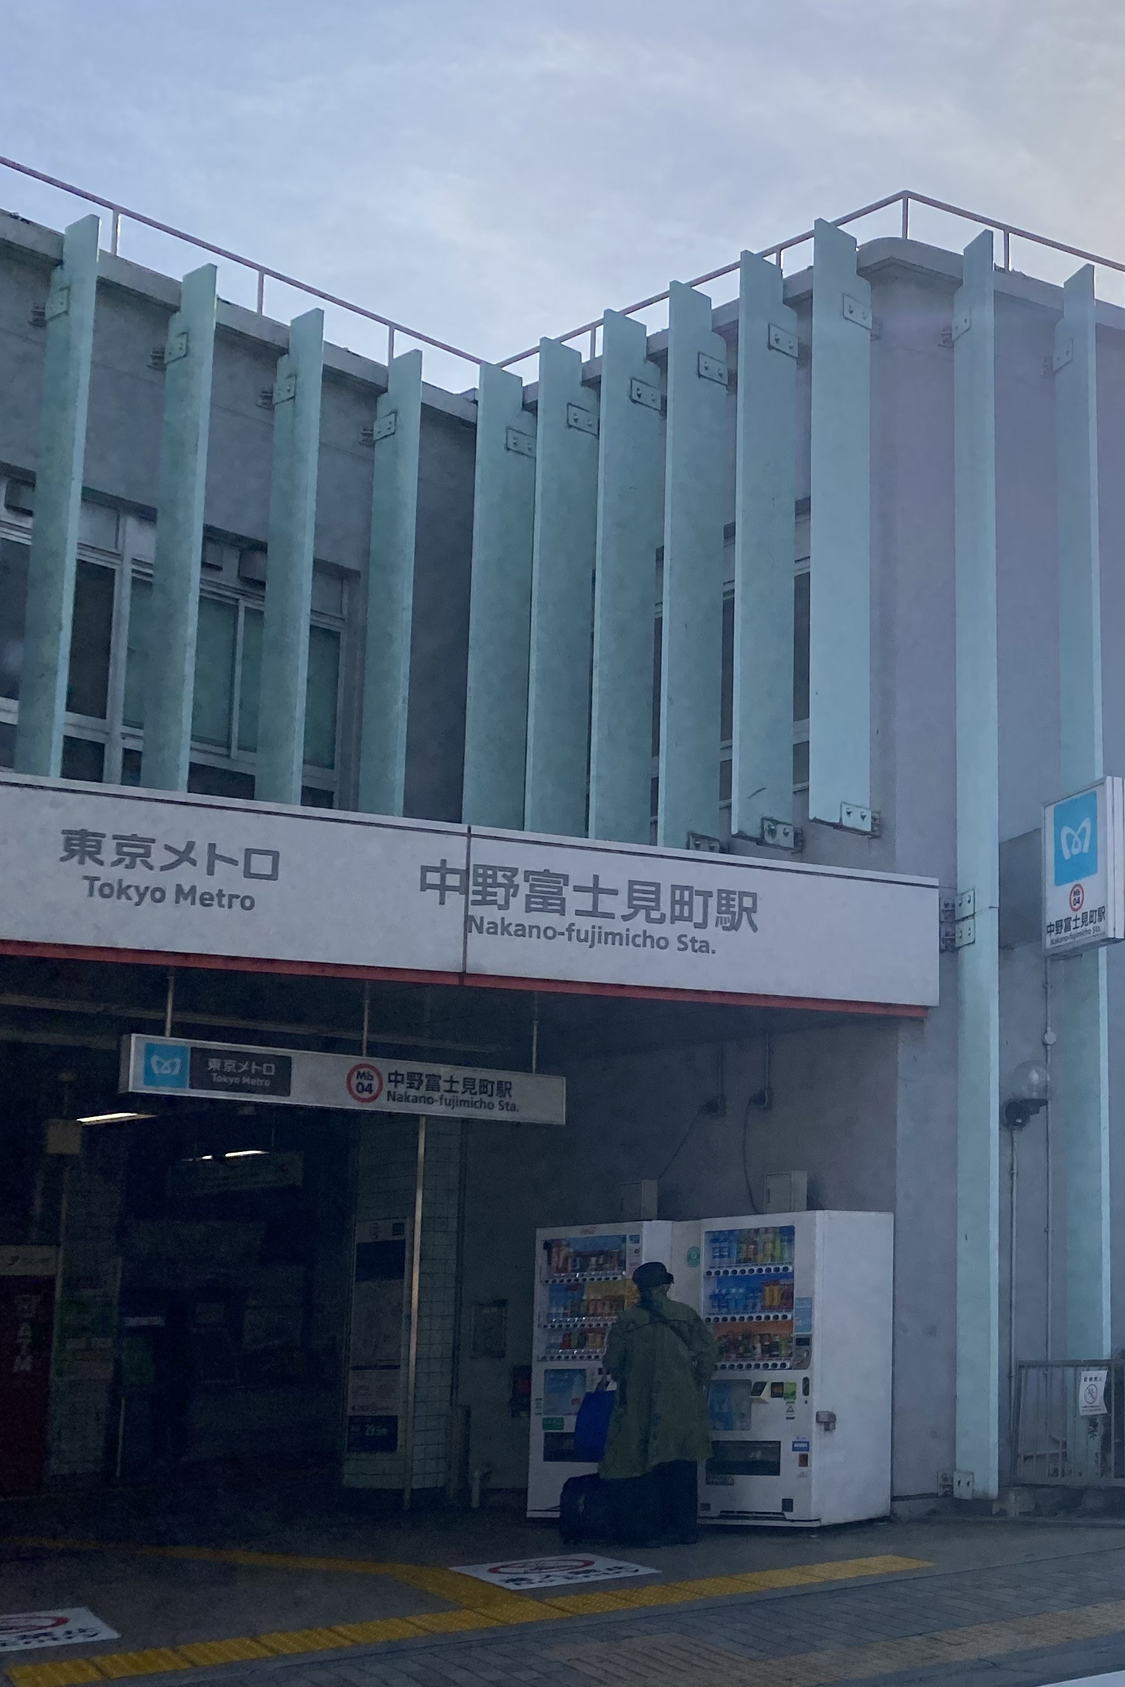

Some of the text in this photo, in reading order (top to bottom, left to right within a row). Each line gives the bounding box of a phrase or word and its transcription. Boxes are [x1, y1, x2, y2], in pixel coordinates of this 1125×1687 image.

[60, 829, 280, 881] 東京メトロ
[82, 875, 255, 911] Tokyo Metro
[420, 858, 758, 933] 中野富士見町駅
[467, 914, 716, 954] Nakano-fujimicho Sta.
[1047, 905, 1106, 937] 中野富士見町駅
[207, 1058, 276, 1075] 東京メトロ
[211, 1073, 271, 1087] Tokyo Metro
[356, 1070, 374, 1081] Mb
[356, 1082, 373, 1095] 04
[387, 1069, 513, 1098] 中野富士見町駅
[387, 1090, 520, 1113] Nakano-fujimicho Sta.
